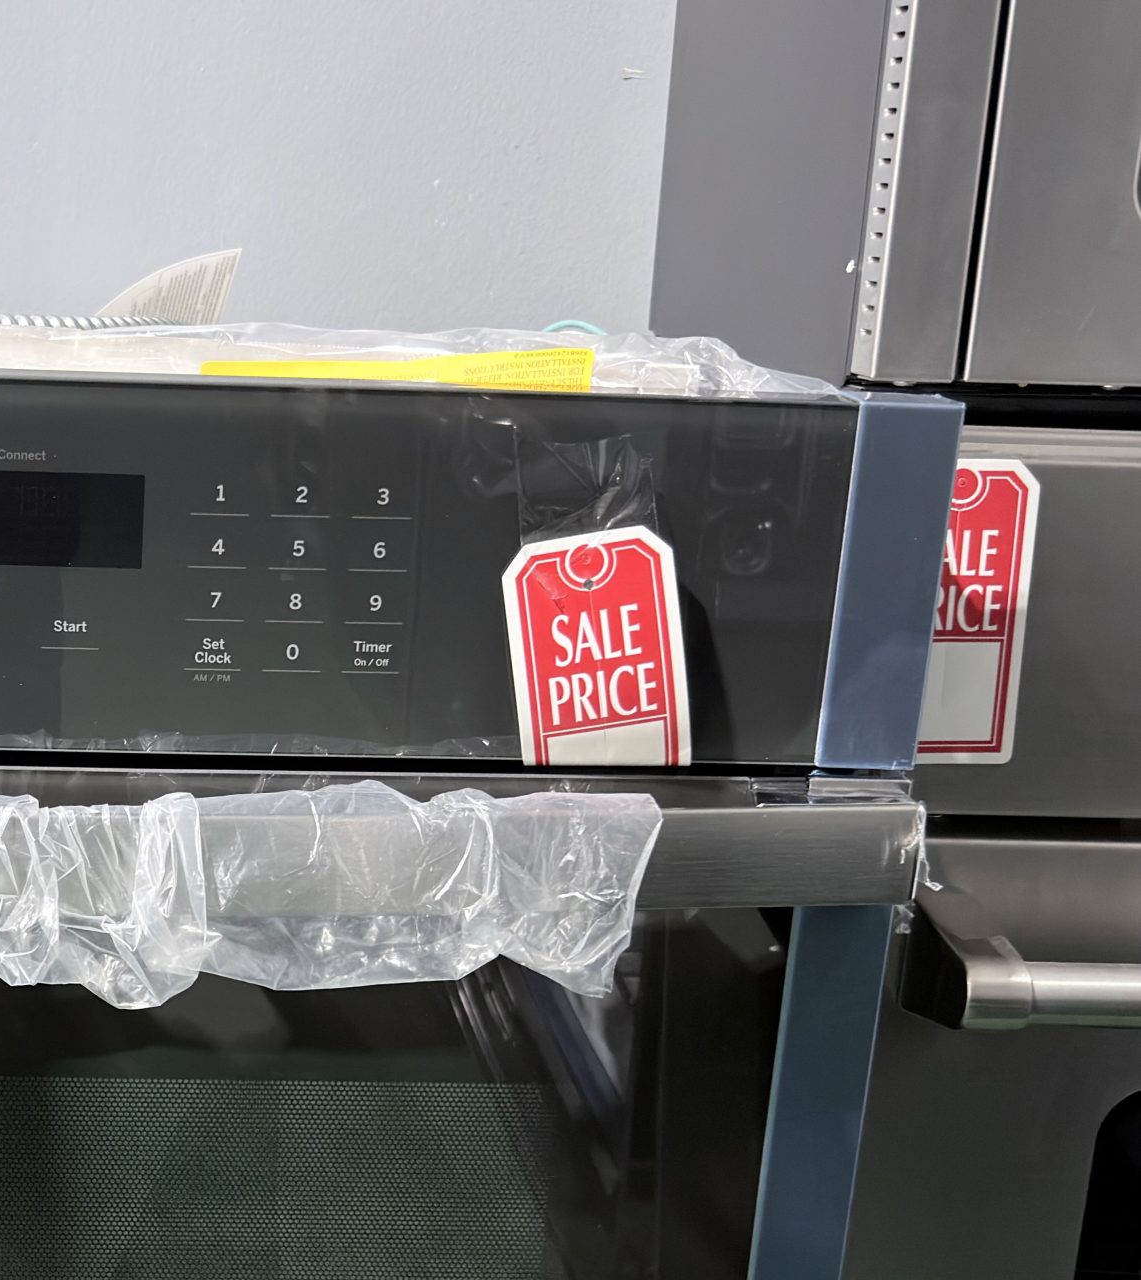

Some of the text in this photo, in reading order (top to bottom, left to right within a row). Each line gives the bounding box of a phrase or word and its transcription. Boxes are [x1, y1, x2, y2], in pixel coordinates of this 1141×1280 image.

[464, 358, 586, 376] INSTALLATION INSTRUCTIONS
[568, 367, 585, 377] FOR
[215, 484, 226, 502] 1
[295, 485, 309, 504] 2
[376, 487, 390, 506] 3
[211, 538, 226, 556] 4
[292, 539, 305, 557] 5
[373, 541, 387, 559] 6
[943, 529, 999, 577] ALE
[210, 591, 222, 609] 7
[289, 592, 302, 610] 8
[369, 594, 383, 612] 9
[934, 584, 1003, 632] ICE
[53, 619, 88, 633] Start
[550, 603, 643, 667] SALE
[202, 637, 226, 650] Set
[286, 643, 300, 661] 0
[353, 640, 393, 653] Timer
[194, 651, 232, 664] Clock
[353, 657, 367, 667] On
[375, 658, 390, 667] Off
[193, 673, 208, 682] AM
[216, 673, 231, 682] PM
[548, 662, 657, 725] PRICE
